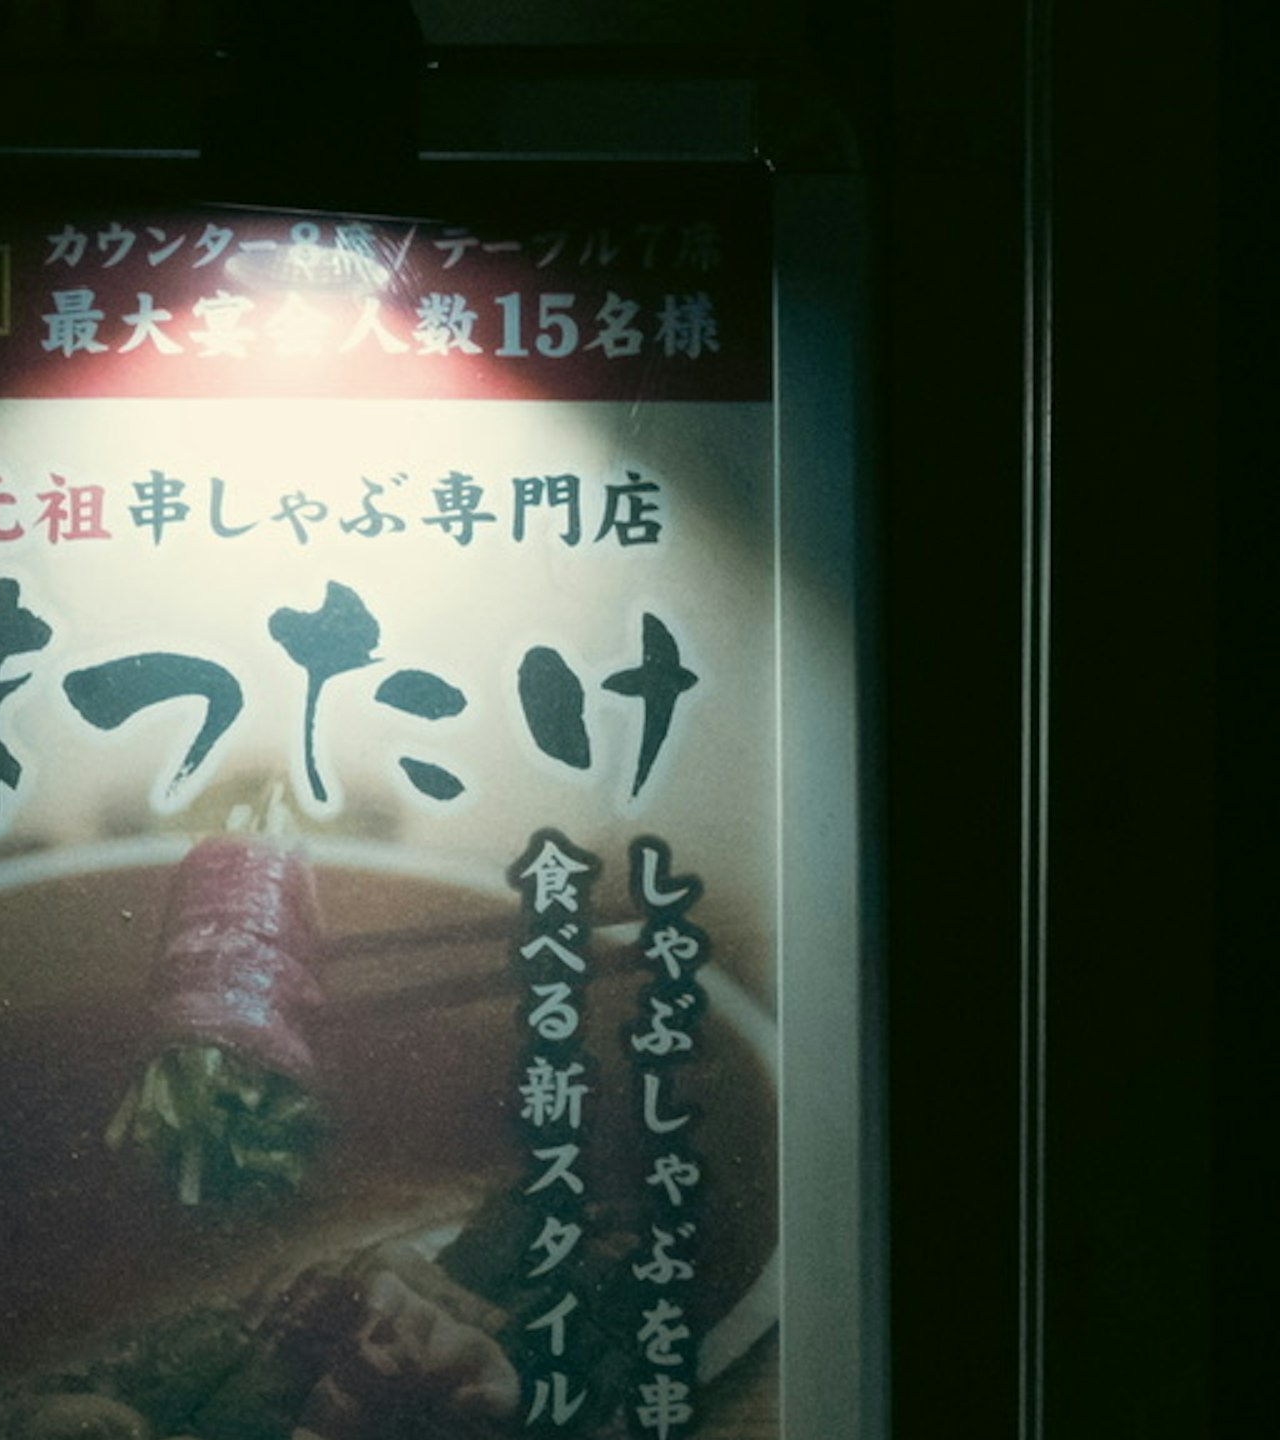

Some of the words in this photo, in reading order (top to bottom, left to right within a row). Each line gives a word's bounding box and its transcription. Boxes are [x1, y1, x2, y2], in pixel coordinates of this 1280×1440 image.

[41, 288, 721, 359] 最大宴会人数15名様
[519, 839, 591, 1428] 食べる新スタイル
